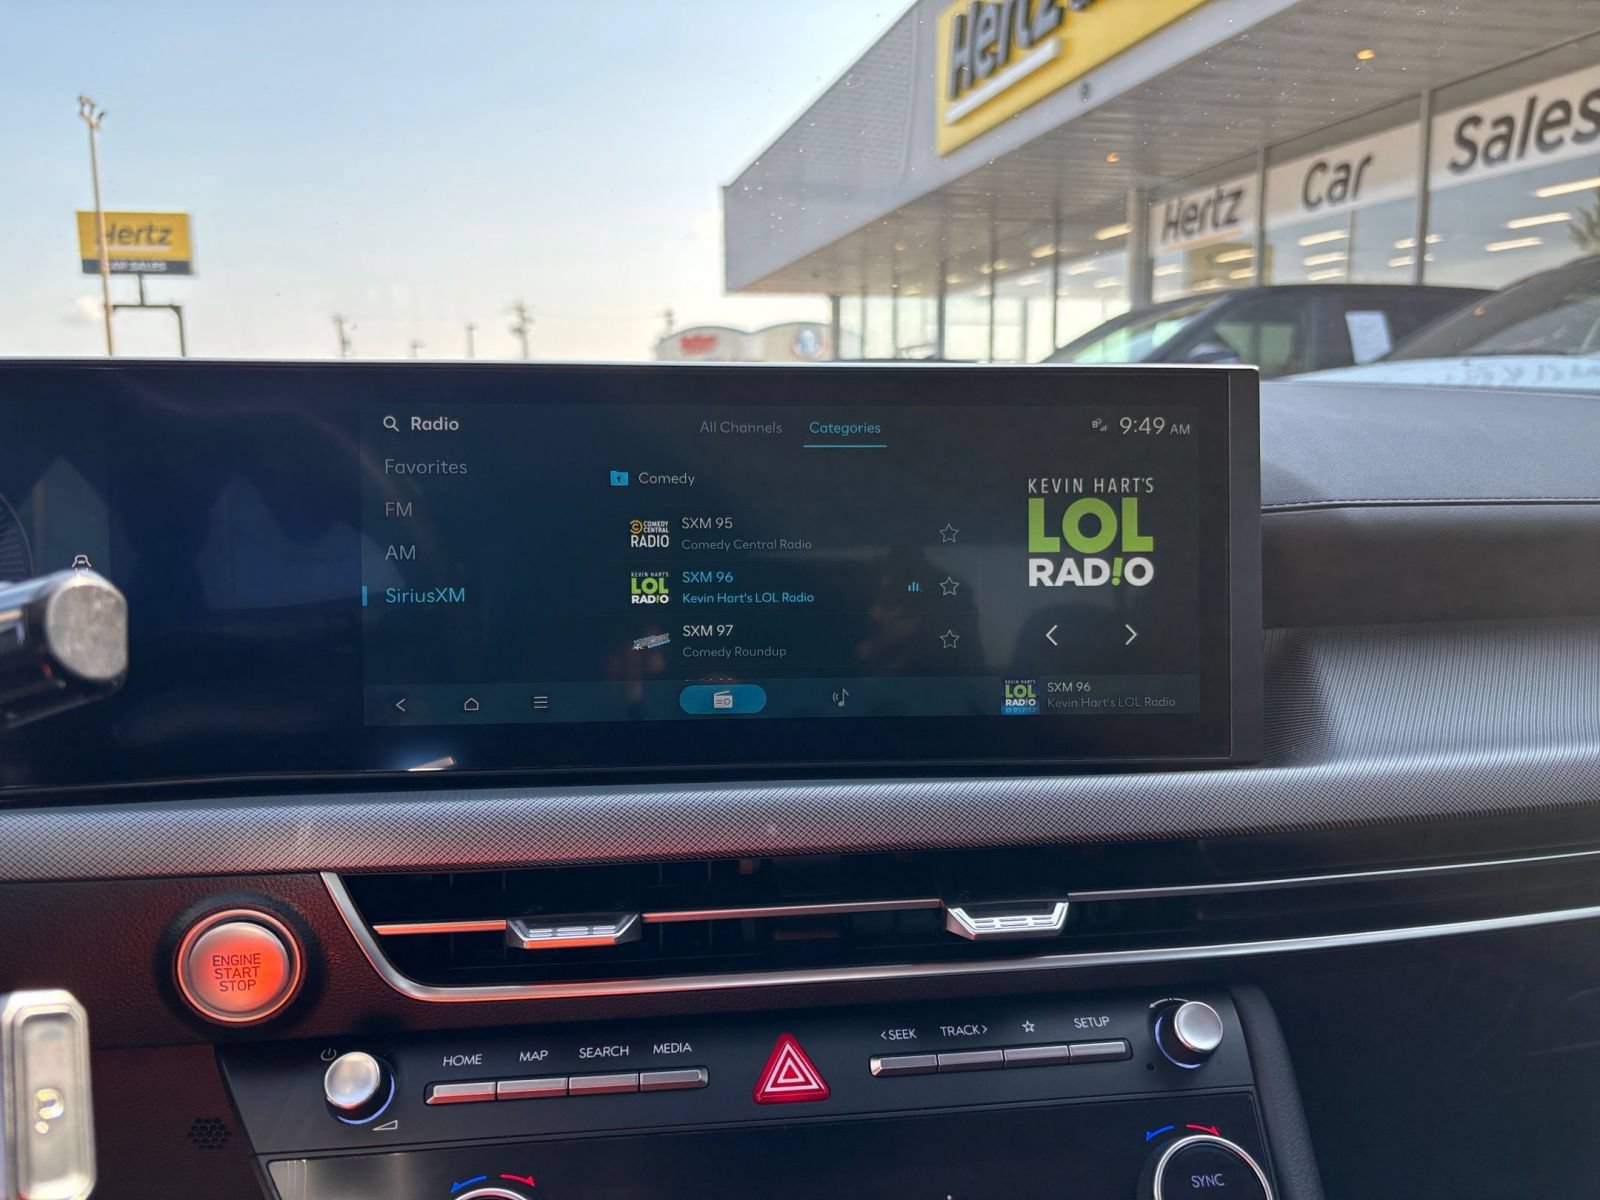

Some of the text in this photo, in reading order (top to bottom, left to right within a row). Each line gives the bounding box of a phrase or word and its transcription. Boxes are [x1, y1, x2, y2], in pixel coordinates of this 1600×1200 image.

[1161, 88, 1600, 244] Hertz Car Sales
[410, 417, 459, 431] Radio
[700, 422, 782, 433] All Channels
[809, 422, 881, 436] Categories
[1119, 416, 1191, 434] 9:49 AM
[384, 458, 468, 474] Favorites
[638, 472, 695, 486] Comedy
[1028, 477, 1155, 493] KEVIN HART'S
[385, 502, 413, 516] FM
[681, 517, 733, 528] SXM 95
[1028, 497, 1154, 554] LOL
[630, 534, 669, 547] RADIO
[681, 539, 812, 551] Comedy Central Radio
[385, 545, 416, 559] AM
[682, 571, 734, 583] SXM 96
[630, 577, 669, 594] LOL
[385, 587, 466, 603] SiriusXM
[682, 592, 814, 603] Kevin Hart's LOL Radio
[682, 625, 734, 636] SXM 97
[682, 646, 787, 659] Comedy Roundup
[1004, 684, 1036, 698] LOL
[1047, 681, 1091, 692] SXM 96
[1047, 696, 1176, 707] Kevin Hart's LOL Radio
[212, 953, 262, 968] ENGINE
[214, 966, 260, 979] START
[219, 979, 257, 992] STOP
[1073, 1016, 1110, 1029] SETUP
[579, 1044, 631, 1059] SEARCH
[652, 1041, 693, 1055] MEDIA
[442, 1053, 483, 1067] HOME
[519, 1049, 549, 1062] MAP
[1190, 1173, 1225, 1188] SYNC
